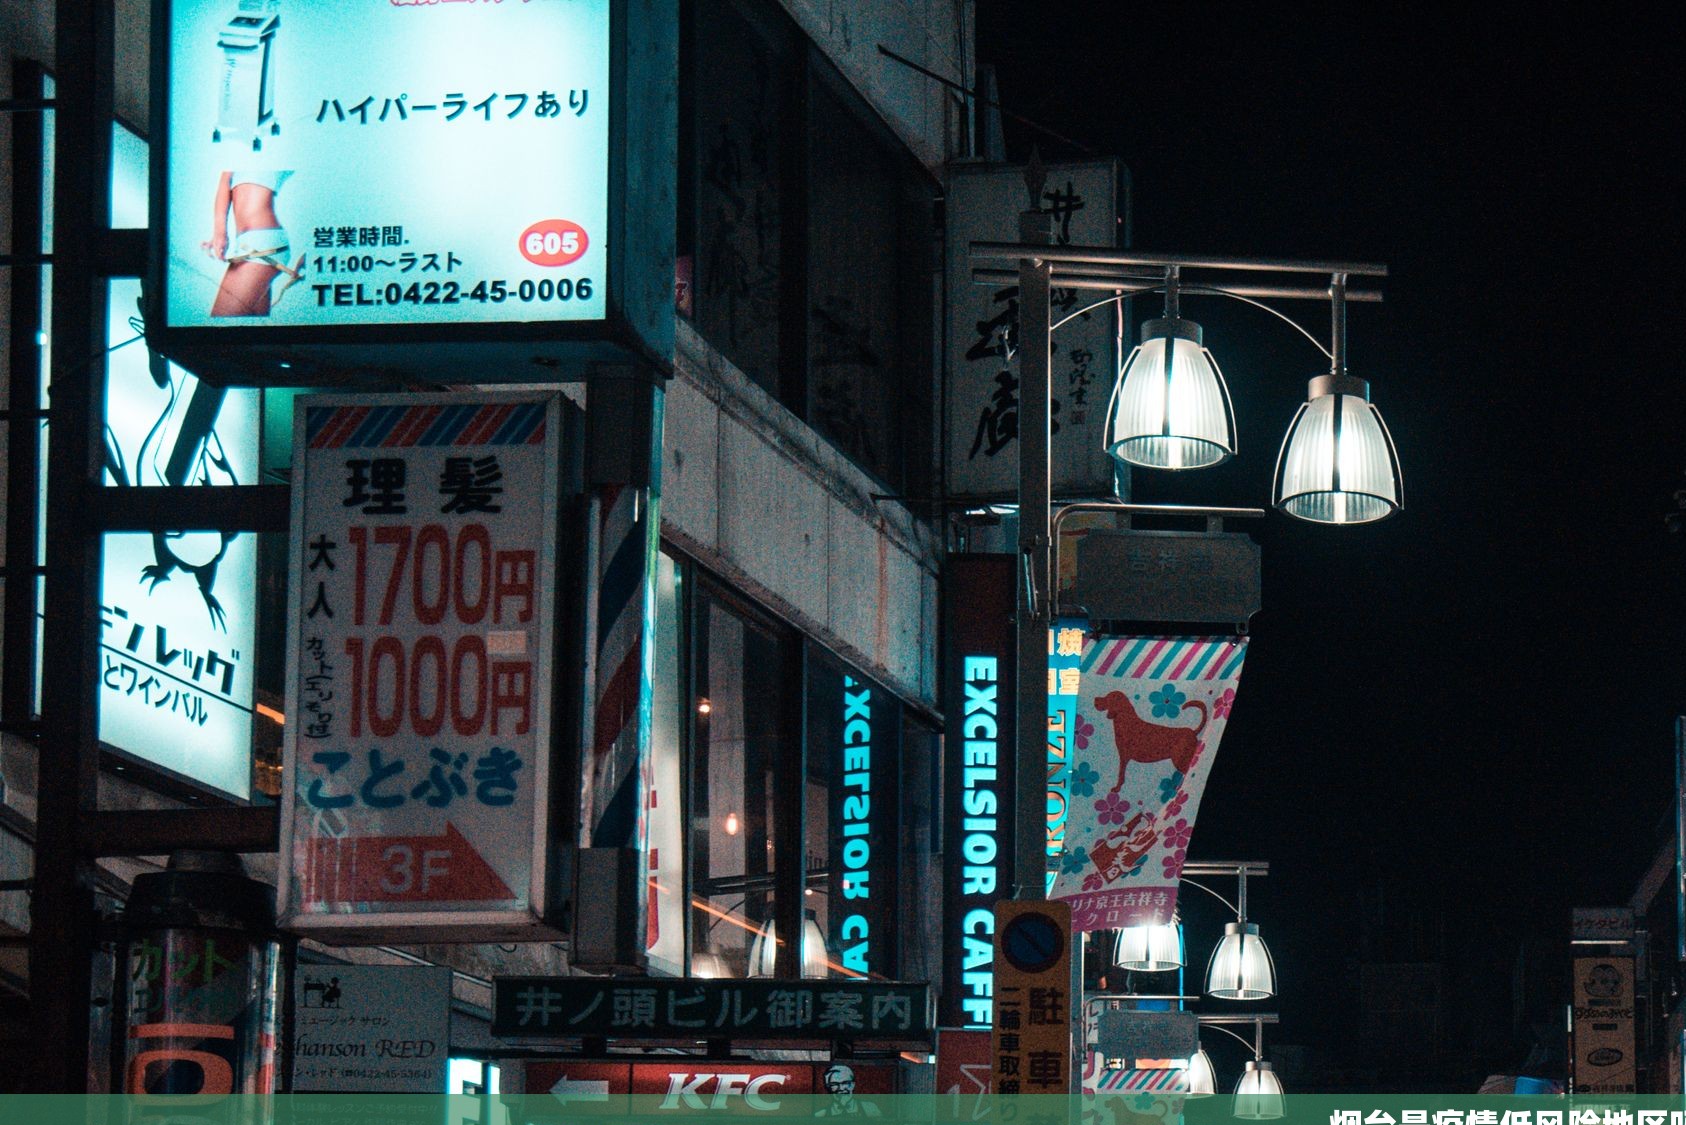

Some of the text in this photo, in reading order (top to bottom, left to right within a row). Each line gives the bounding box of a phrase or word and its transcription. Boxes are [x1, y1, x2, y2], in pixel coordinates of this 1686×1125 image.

[316, 89, 591, 124] ハイパーライフあり
[526, 231, 579, 255] 605
[312, 278, 593, 307] TEL:0422-45-0006
[343, 455, 502, 515] 理髪
[305, 534, 337, 621] 大人
[348, 523, 537, 627] 1700円
[344, 634, 533, 738] 1000円
[306, 748, 525, 809] ことぶき
[963, 655, 998, 896] EXCELSIOR
[381, 845, 452, 894] 3F
[963, 908, 994, 1030] CAFF
[515, 984, 915, 1031] 井ノ頭ビル御案内
[659, 1072, 787, 1111] KFC
